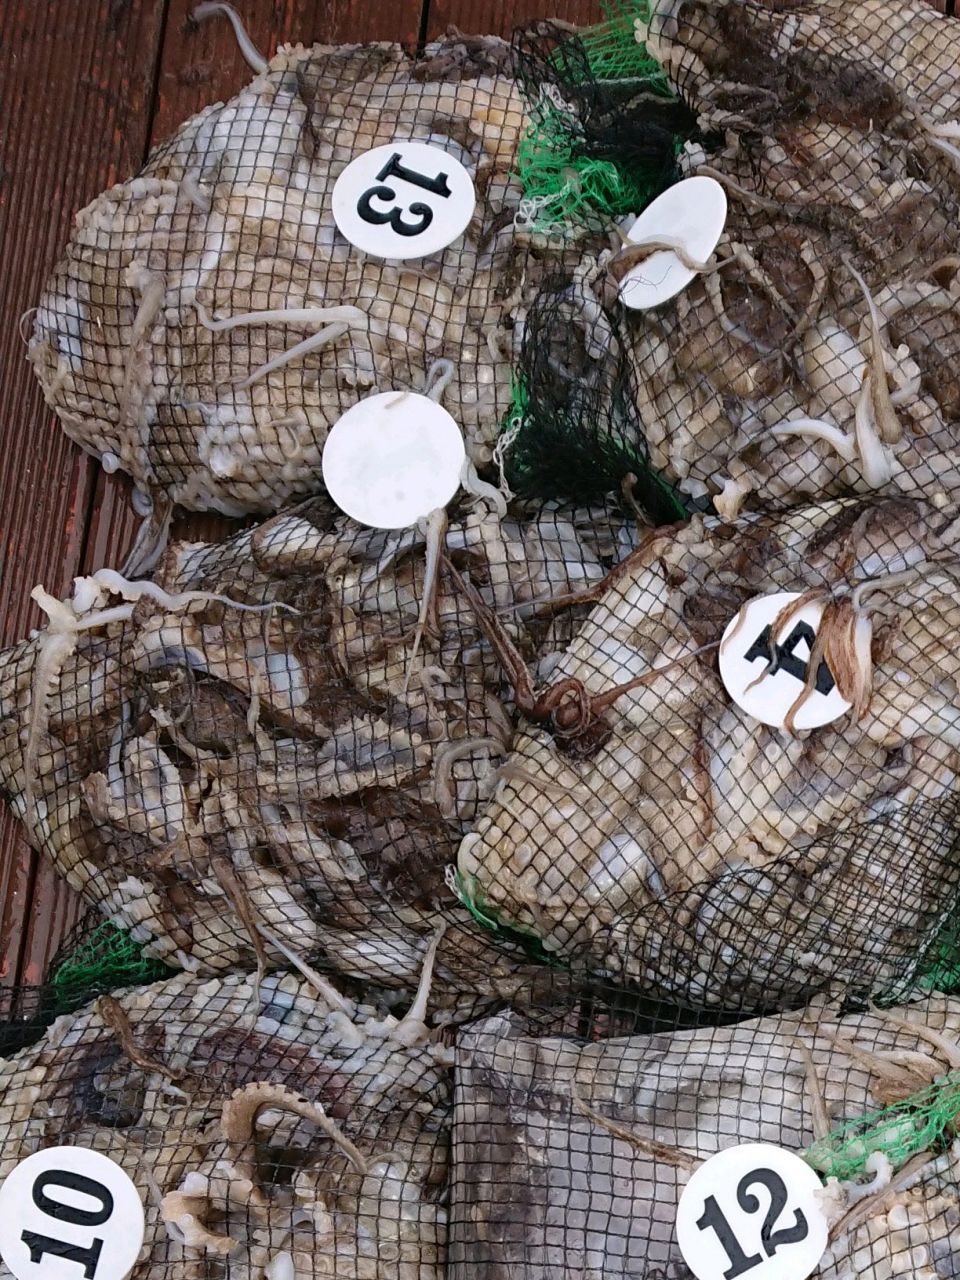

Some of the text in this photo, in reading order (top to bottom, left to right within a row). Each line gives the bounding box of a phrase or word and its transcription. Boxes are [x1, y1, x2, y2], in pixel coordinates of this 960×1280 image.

[356, 153, 452, 237] 13
[743, 619, 836, 697] 4
[20, 1169, 114, 1280] 10
